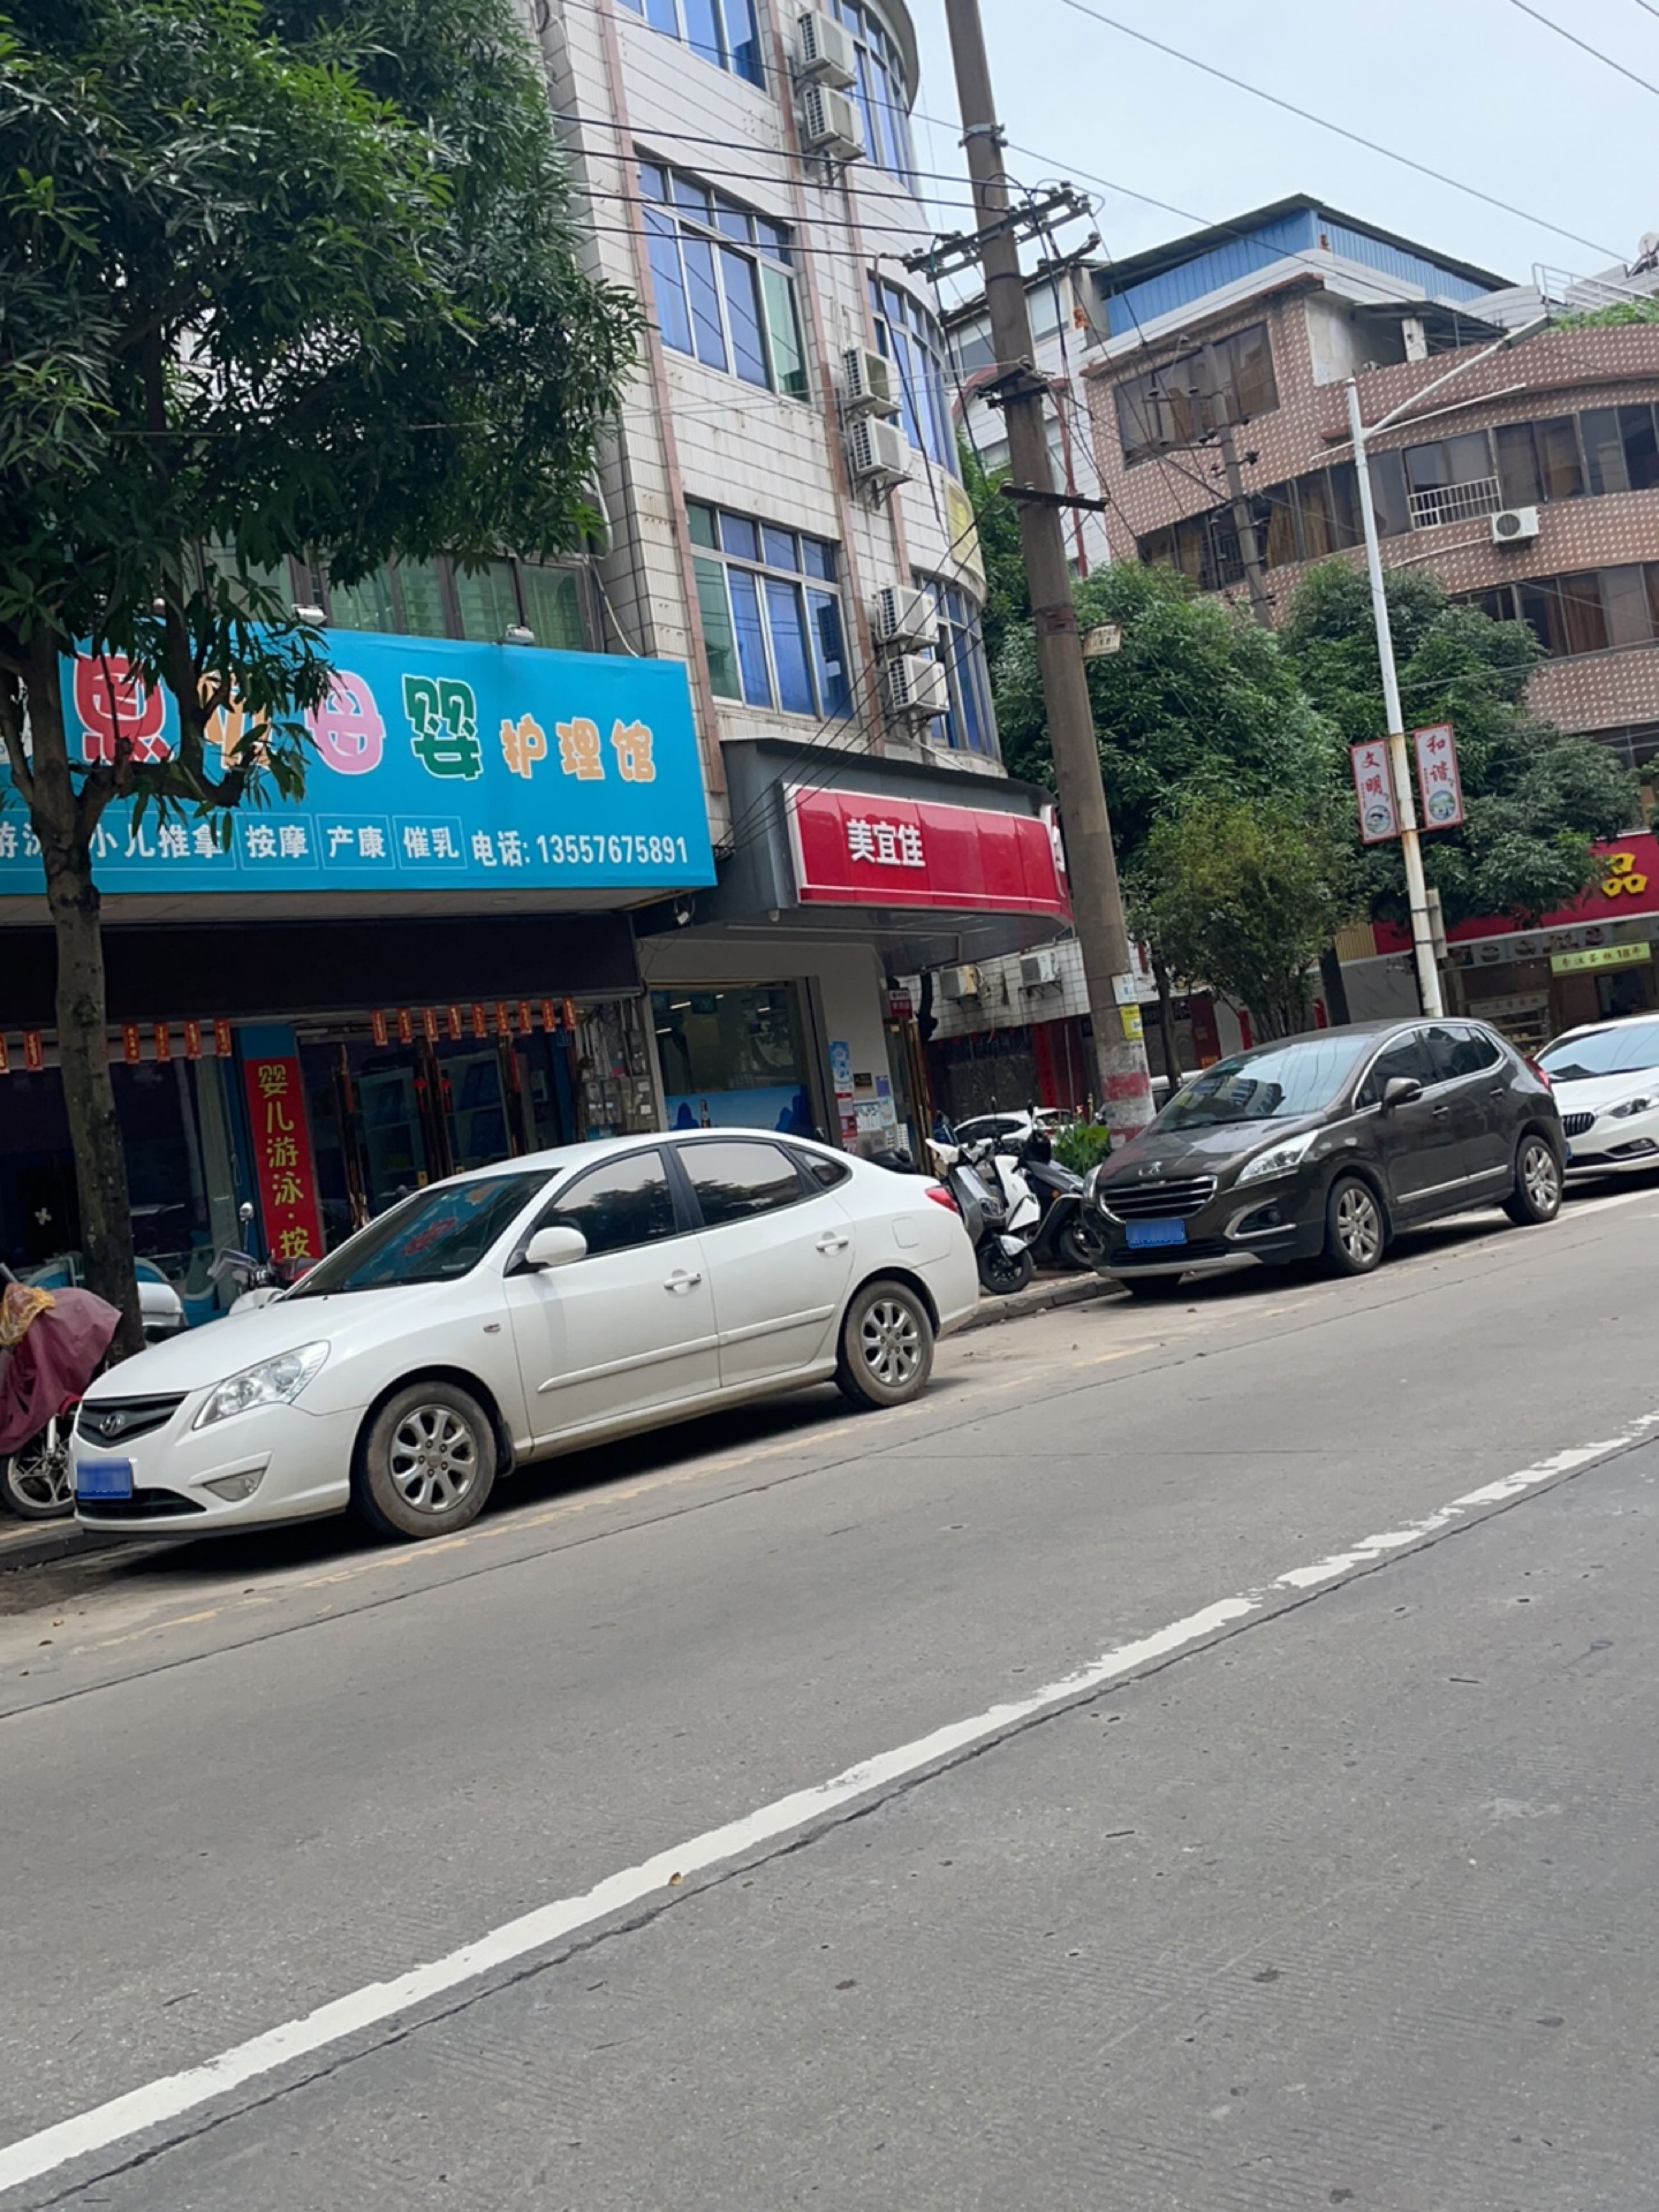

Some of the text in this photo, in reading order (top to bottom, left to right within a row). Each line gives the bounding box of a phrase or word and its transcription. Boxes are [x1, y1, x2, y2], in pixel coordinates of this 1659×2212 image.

[1362, 751, 1382, 796] 文明
[1426, 735, 1449, 782] 和谐
[89, 823, 223, 859] 小儿推拿
[245, 824, 310, 859] 按摩
[326, 826, 387, 859] 产康
[403, 826, 460, 860] 催乳
[846, 819, 926, 868] 美宜佳
[1602, 852, 1648, 897] 品
